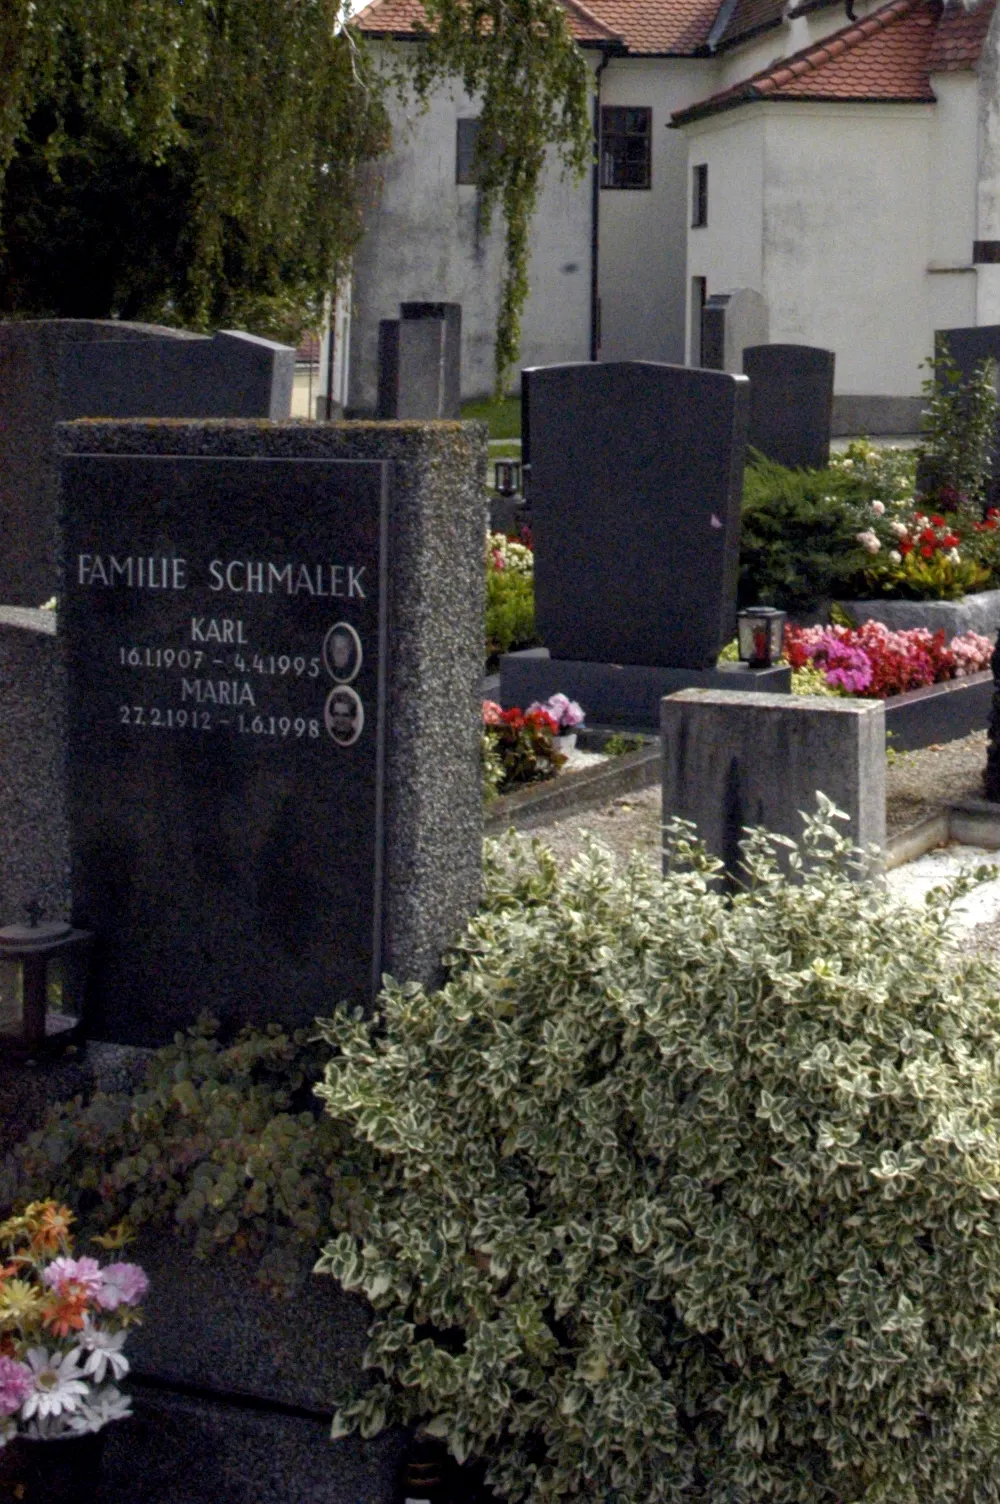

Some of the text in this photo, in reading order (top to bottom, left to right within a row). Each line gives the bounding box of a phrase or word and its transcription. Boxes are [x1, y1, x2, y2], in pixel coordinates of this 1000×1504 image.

[78, 554, 367, 599] FAMILIE SCHMALEK
[191, 617, 248, 645] KARL
[234, 654, 321, 678] 4.4.1995
[181, 678, 256, 707] MARIA
[238, 714, 321, 739] 1.6.1998
